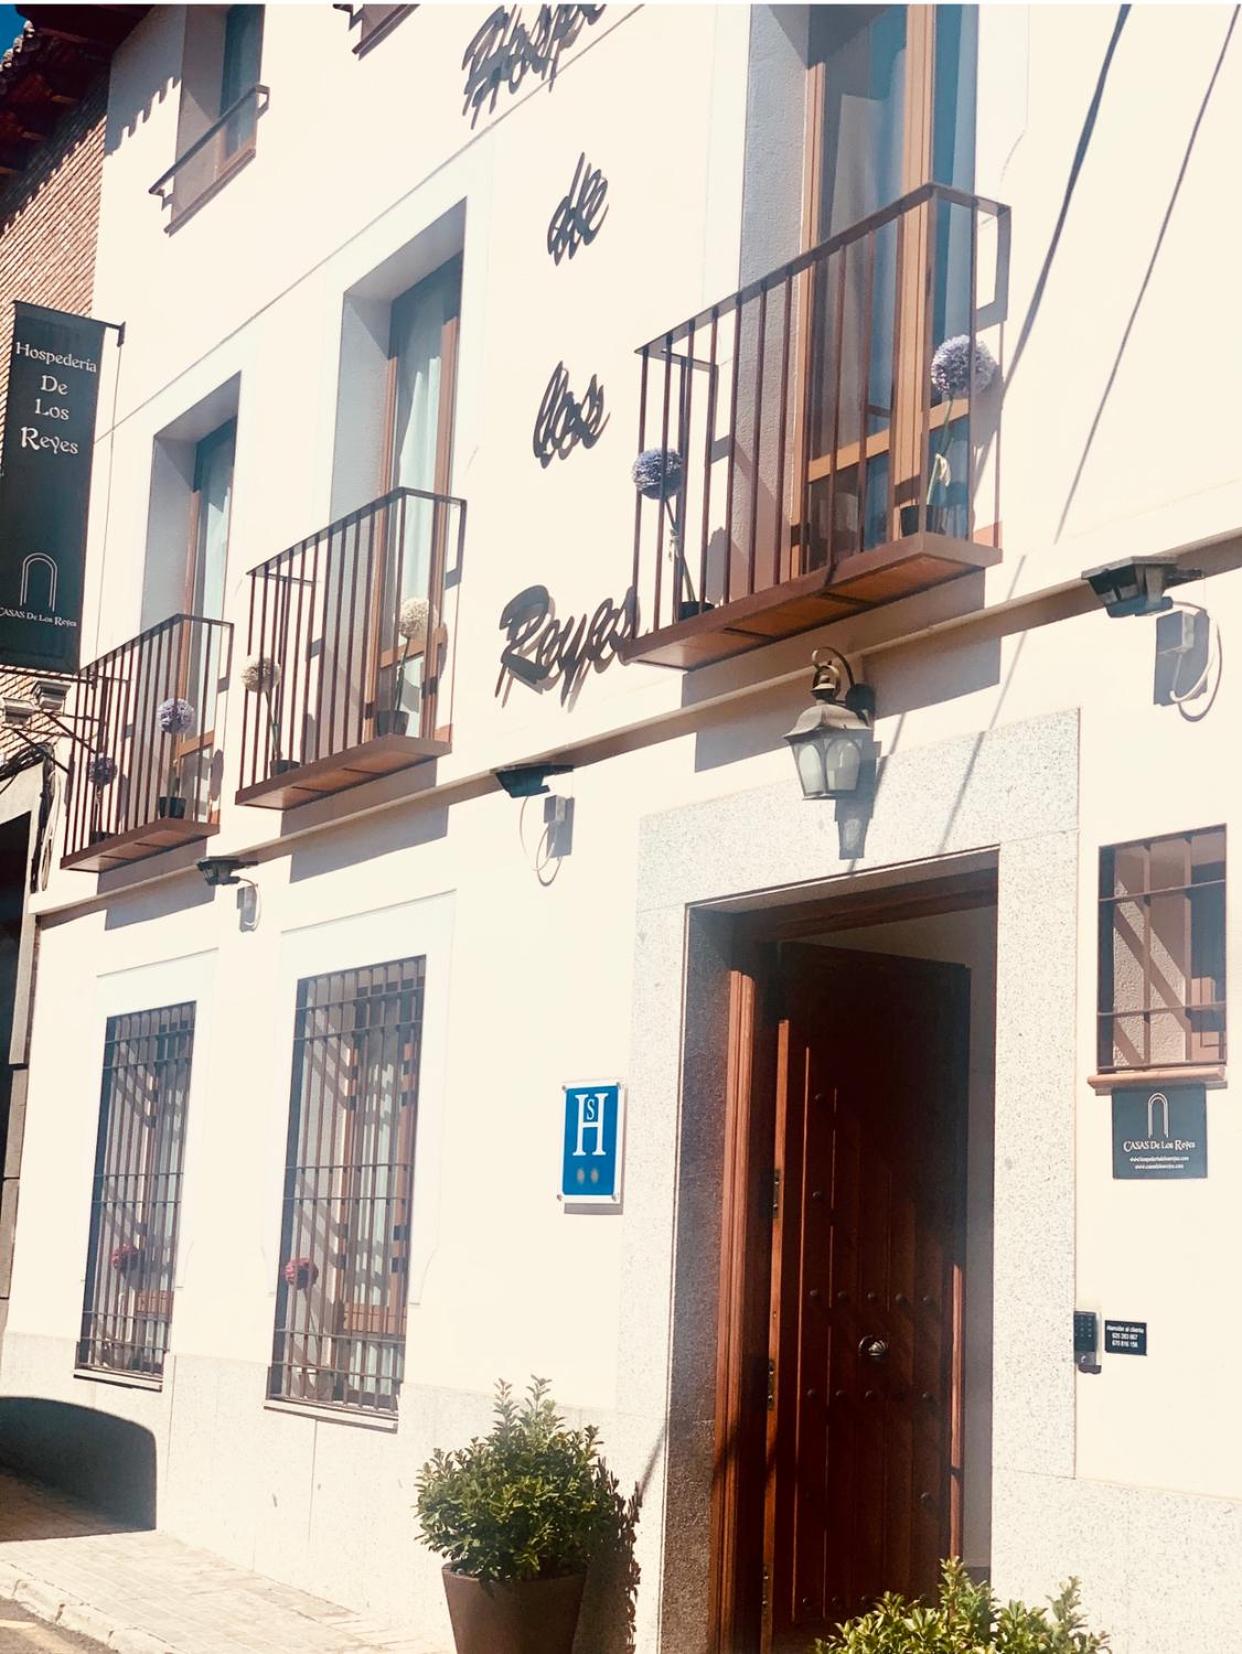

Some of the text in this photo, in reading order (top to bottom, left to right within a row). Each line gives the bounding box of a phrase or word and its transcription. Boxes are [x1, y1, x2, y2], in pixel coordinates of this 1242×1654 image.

[547, 152, 609, 264] de
[41, 375, 69, 395] De
[34, 398, 70, 420] Los
[20, 426, 79, 454] Reyes
[495, 585, 639, 708] Reyes
